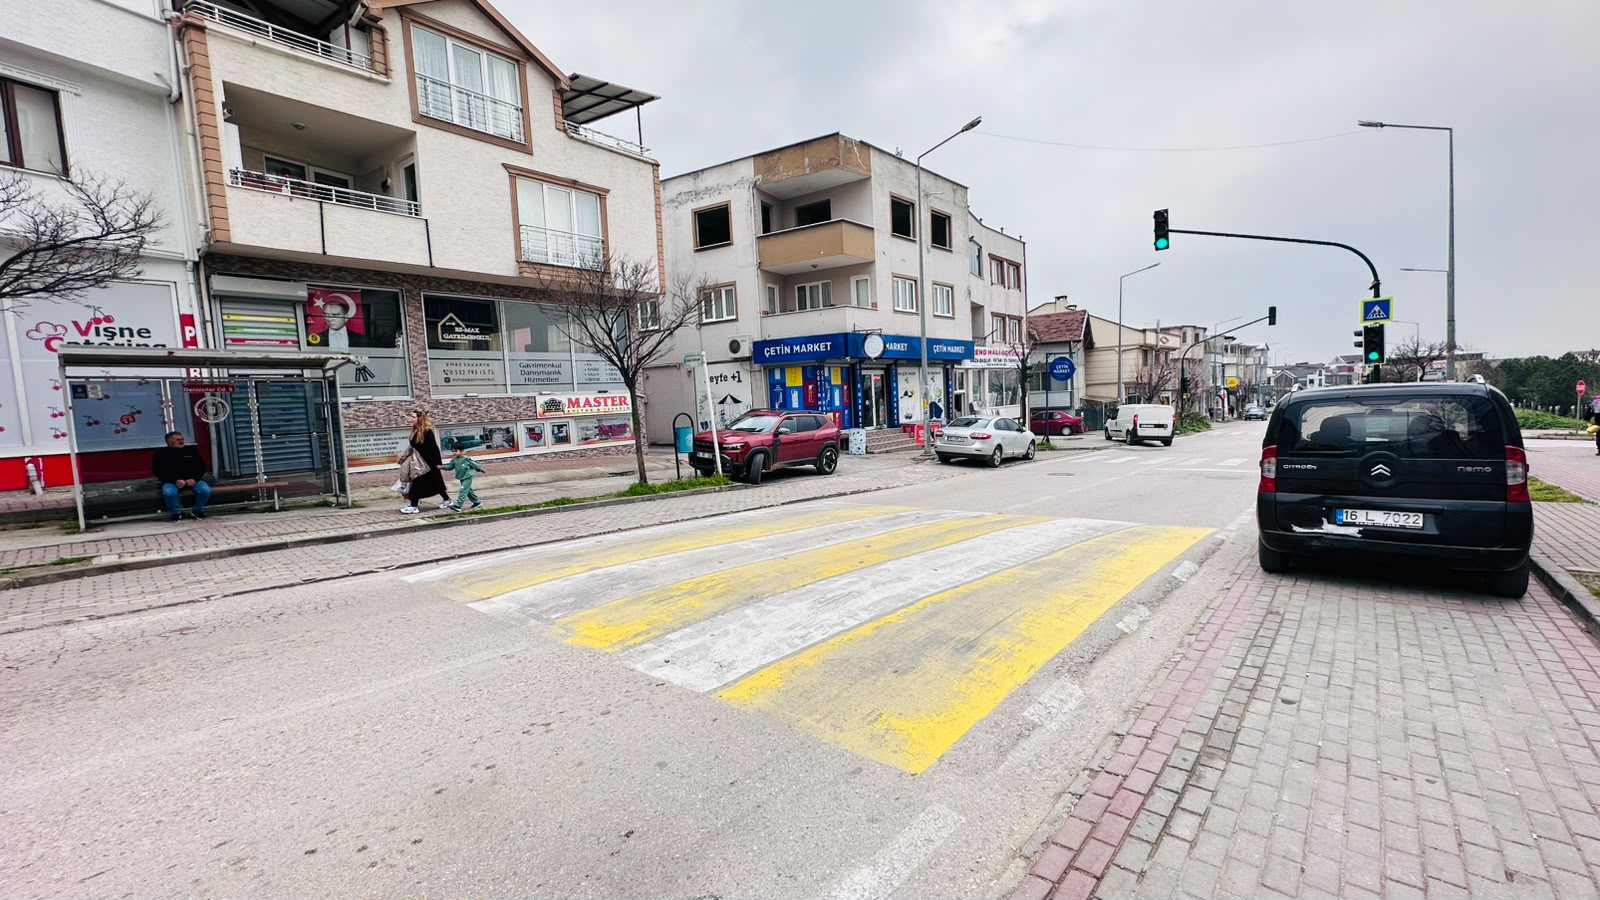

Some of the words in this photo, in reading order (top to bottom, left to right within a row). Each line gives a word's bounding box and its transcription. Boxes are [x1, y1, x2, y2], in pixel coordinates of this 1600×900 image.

[72, 320, 152, 340] Vişne
[764, 343, 791, 358] ÇETİN
[793, 341, 832, 354] MARKET
[933, 344, 947, 354] ÇETİN
[948, 346, 965, 354] MARKET
[519, 362, 562, 370] Gayrimenkul
[709, 372, 729, 385] eyfe
[567, 395, 629, 409] MASTER
[1343, 510, 1358, 521] 16
[1365, 511, 1375, 521] L
[1383, 512, 1421, 525] 7022
